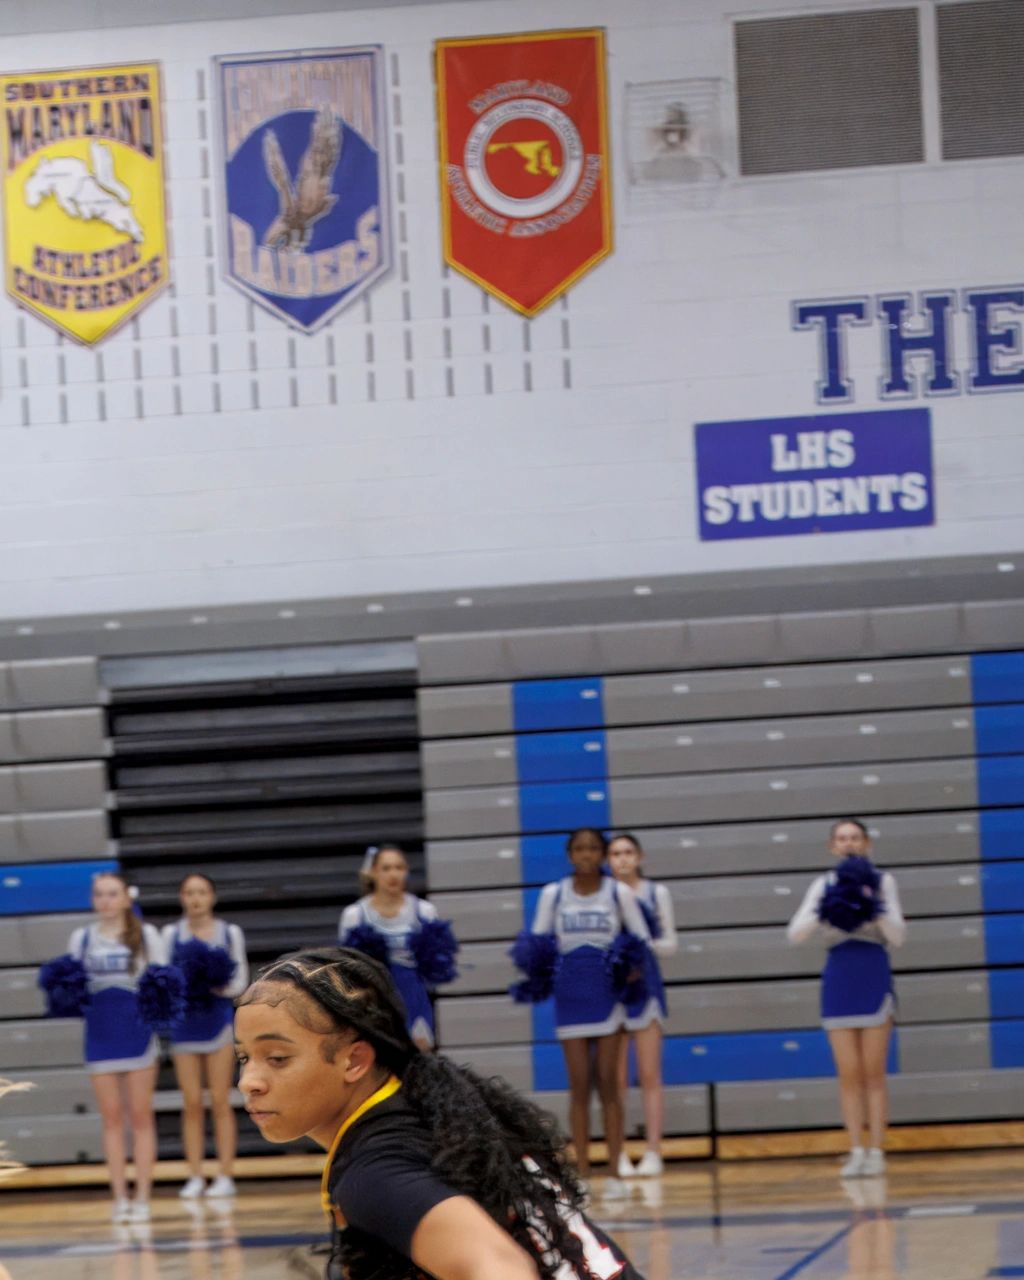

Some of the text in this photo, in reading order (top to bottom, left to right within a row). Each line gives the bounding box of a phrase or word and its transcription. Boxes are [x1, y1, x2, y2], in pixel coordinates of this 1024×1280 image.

[4, 73, 150, 101] SOUTHERN
[5, 97, 155, 172] MARYLAND
[12, 254, 163, 312] CONFERENCE
[32, 238, 142, 279] ATHLETIC
[789, 283, 1024, 405] THE
[770, 429, 856, 473] LHS
[703, 472, 929, 526] STUDENTS
